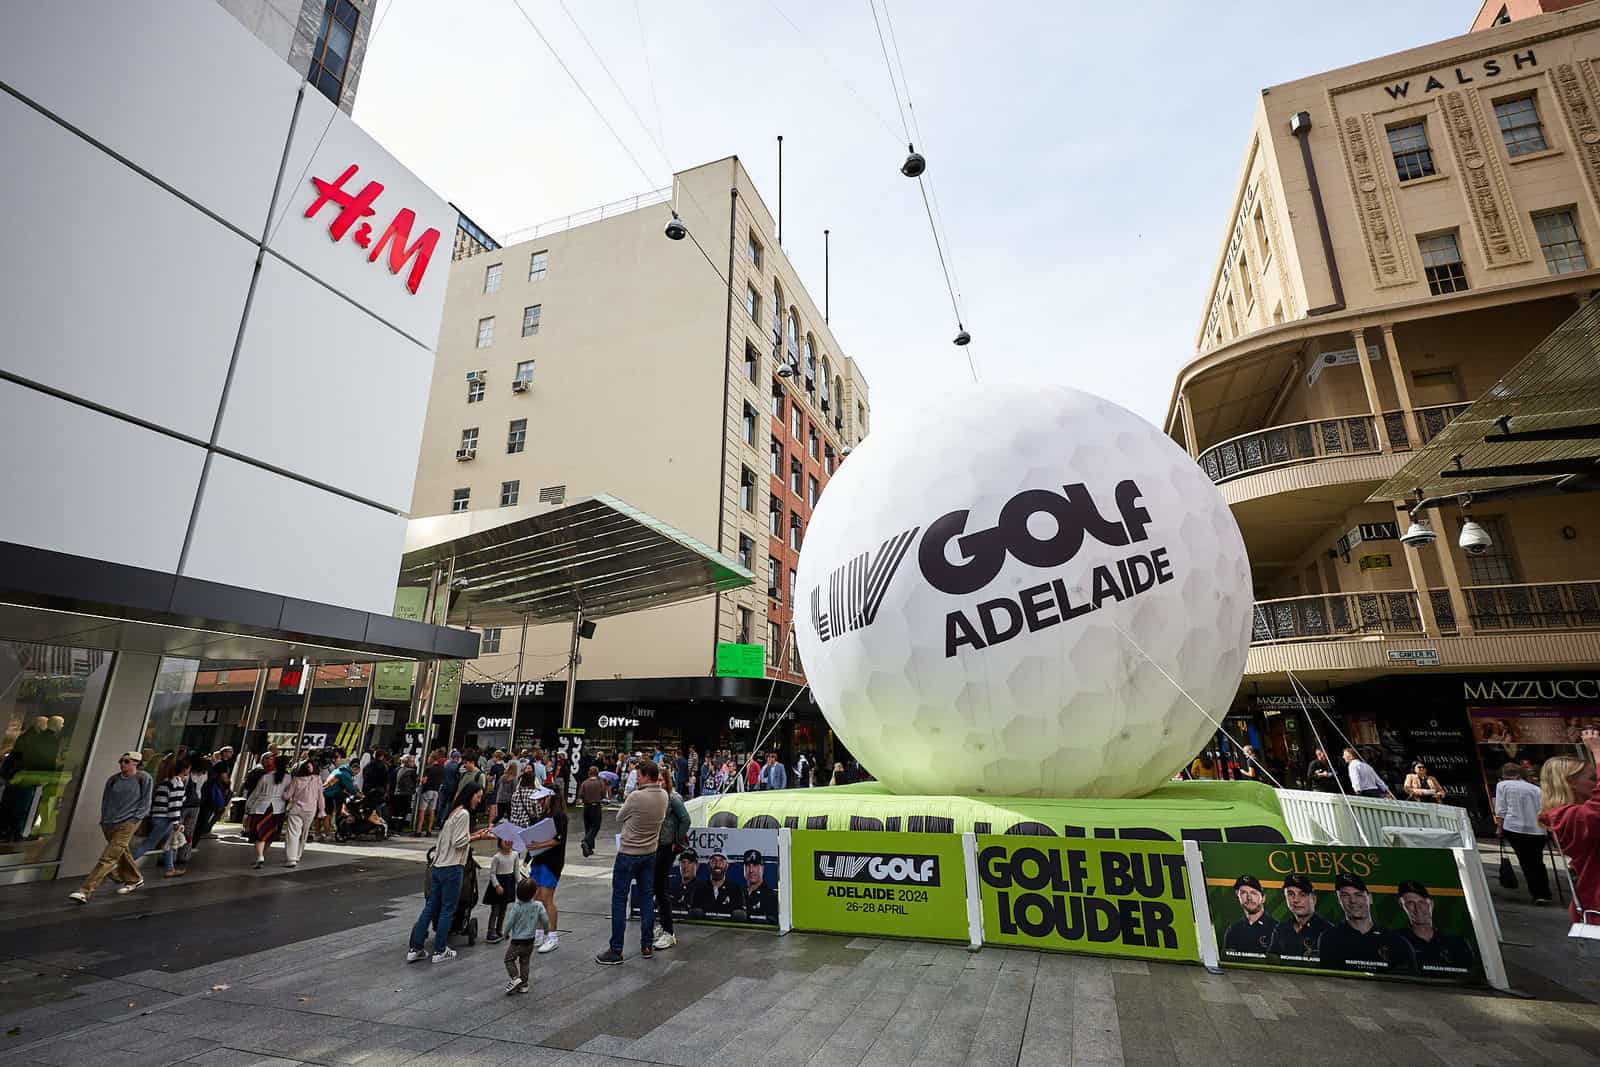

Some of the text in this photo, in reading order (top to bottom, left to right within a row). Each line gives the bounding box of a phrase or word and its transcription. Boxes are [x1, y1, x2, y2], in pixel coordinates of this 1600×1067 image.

[1384, 49, 1537, 100] WALSH
[304, 164, 441, 295] H&M
[810, 479, 1153, 643] LIV GOLF
[945, 547, 1174, 658] ADELAIDE
[504, 682, 545, 697] HYPE
[1463, 680, 1600, 700] MAZZUCC
[486, 718, 513, 728] HYPE
[608, 716, 640, 727] HYPE
[734, 719, 750, 729] HYPE
[818, 854, 935, 882] LIV GOLF
[1100, 850, 1188, 900] BUT
[1268, 850, 1371, 877] CLEEKS
[827, 885, 928, 903] ADELAIDE 2024
[846, 902, 908, 915] 26-28 APRIL
[997, 891, 1178, 949] LOUDER
